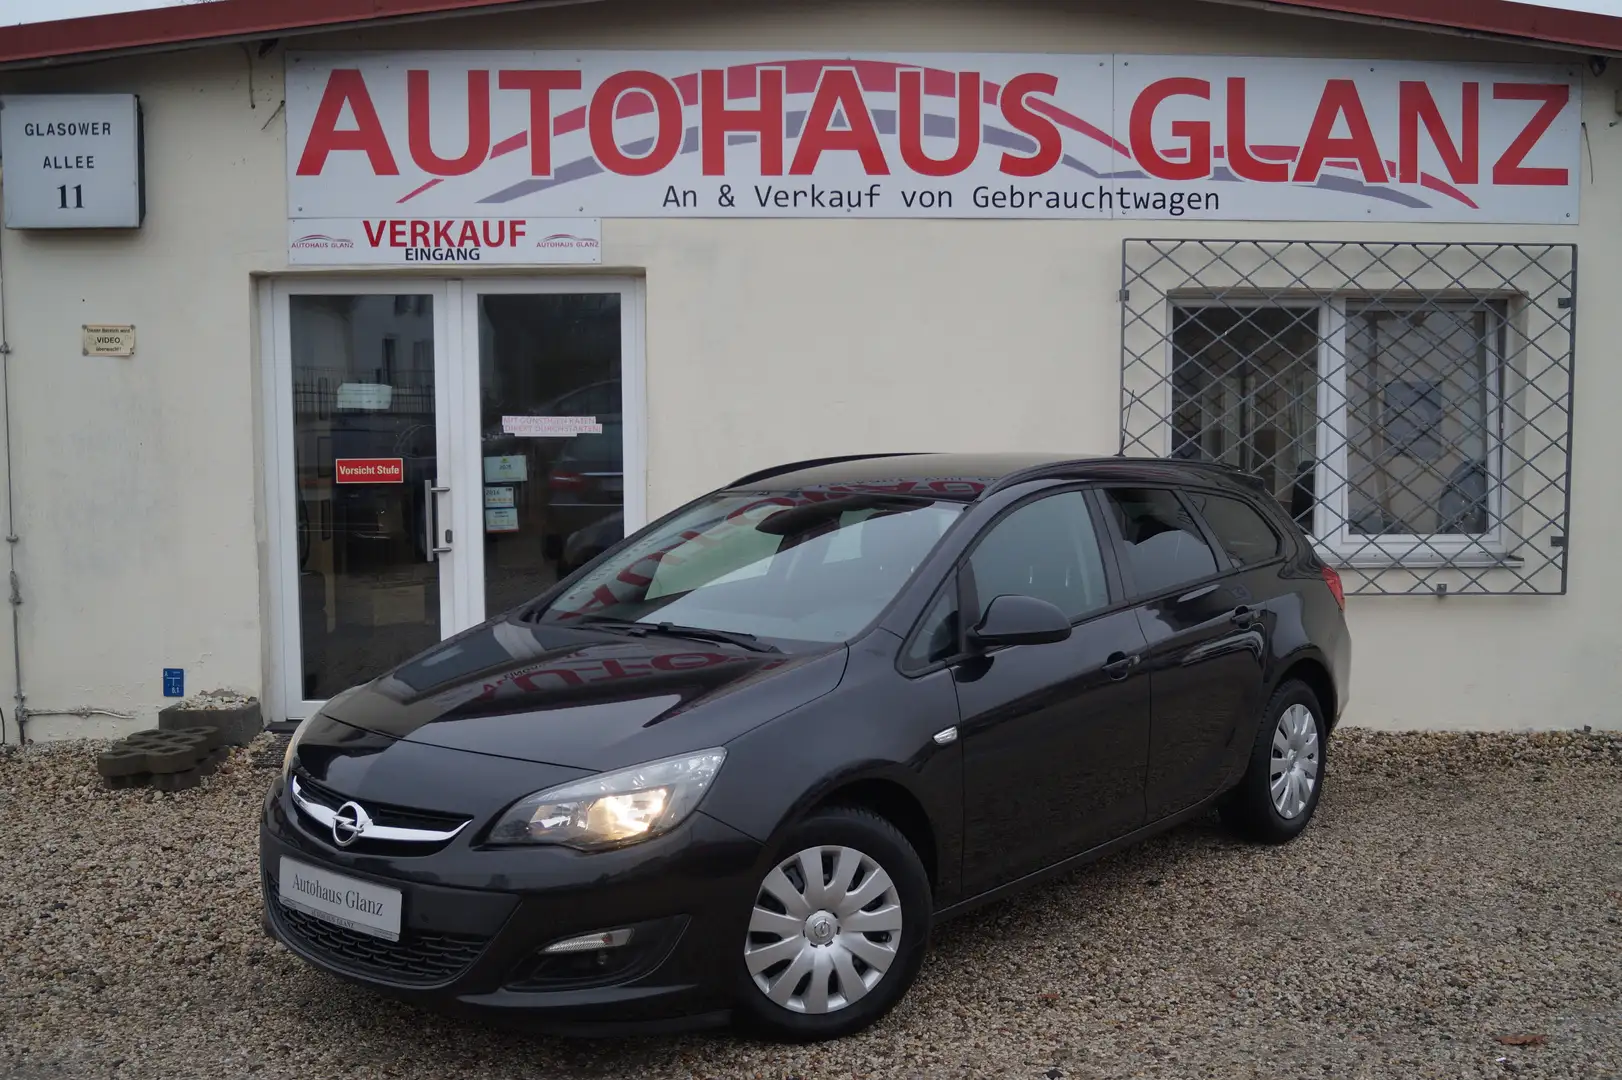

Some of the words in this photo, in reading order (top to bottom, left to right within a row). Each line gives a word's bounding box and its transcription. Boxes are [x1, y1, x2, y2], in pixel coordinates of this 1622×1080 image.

[25, 122, 111, 136] GLASOWER
[296, 68, 1062, 177] AUTOHAUS
[1129, 76, 1569, 186] GLANZ
[43, 156, 94, 169] ALLEE
[57, 184, 84, 209] 11
[663, 185, 697, 208] An
[717, 184, 735, 208] &
[754, 184, 880, 208] Verkauf
[901, 190, 952, 208] von
[973, 185, 1219, 216] Gebrauchtwagen
[363, 219, 526, 248] VERKAUF
[405, 248, 480, 261] EINGANG
[97, 336, 121, 344] VIDEO
[339, 465, 375, 475] Vorsicht
[377, 465, 400, 475] Stufe
[292, 873, 342, 905] Autohaus
[345, 890, 384, 917] Glanz
